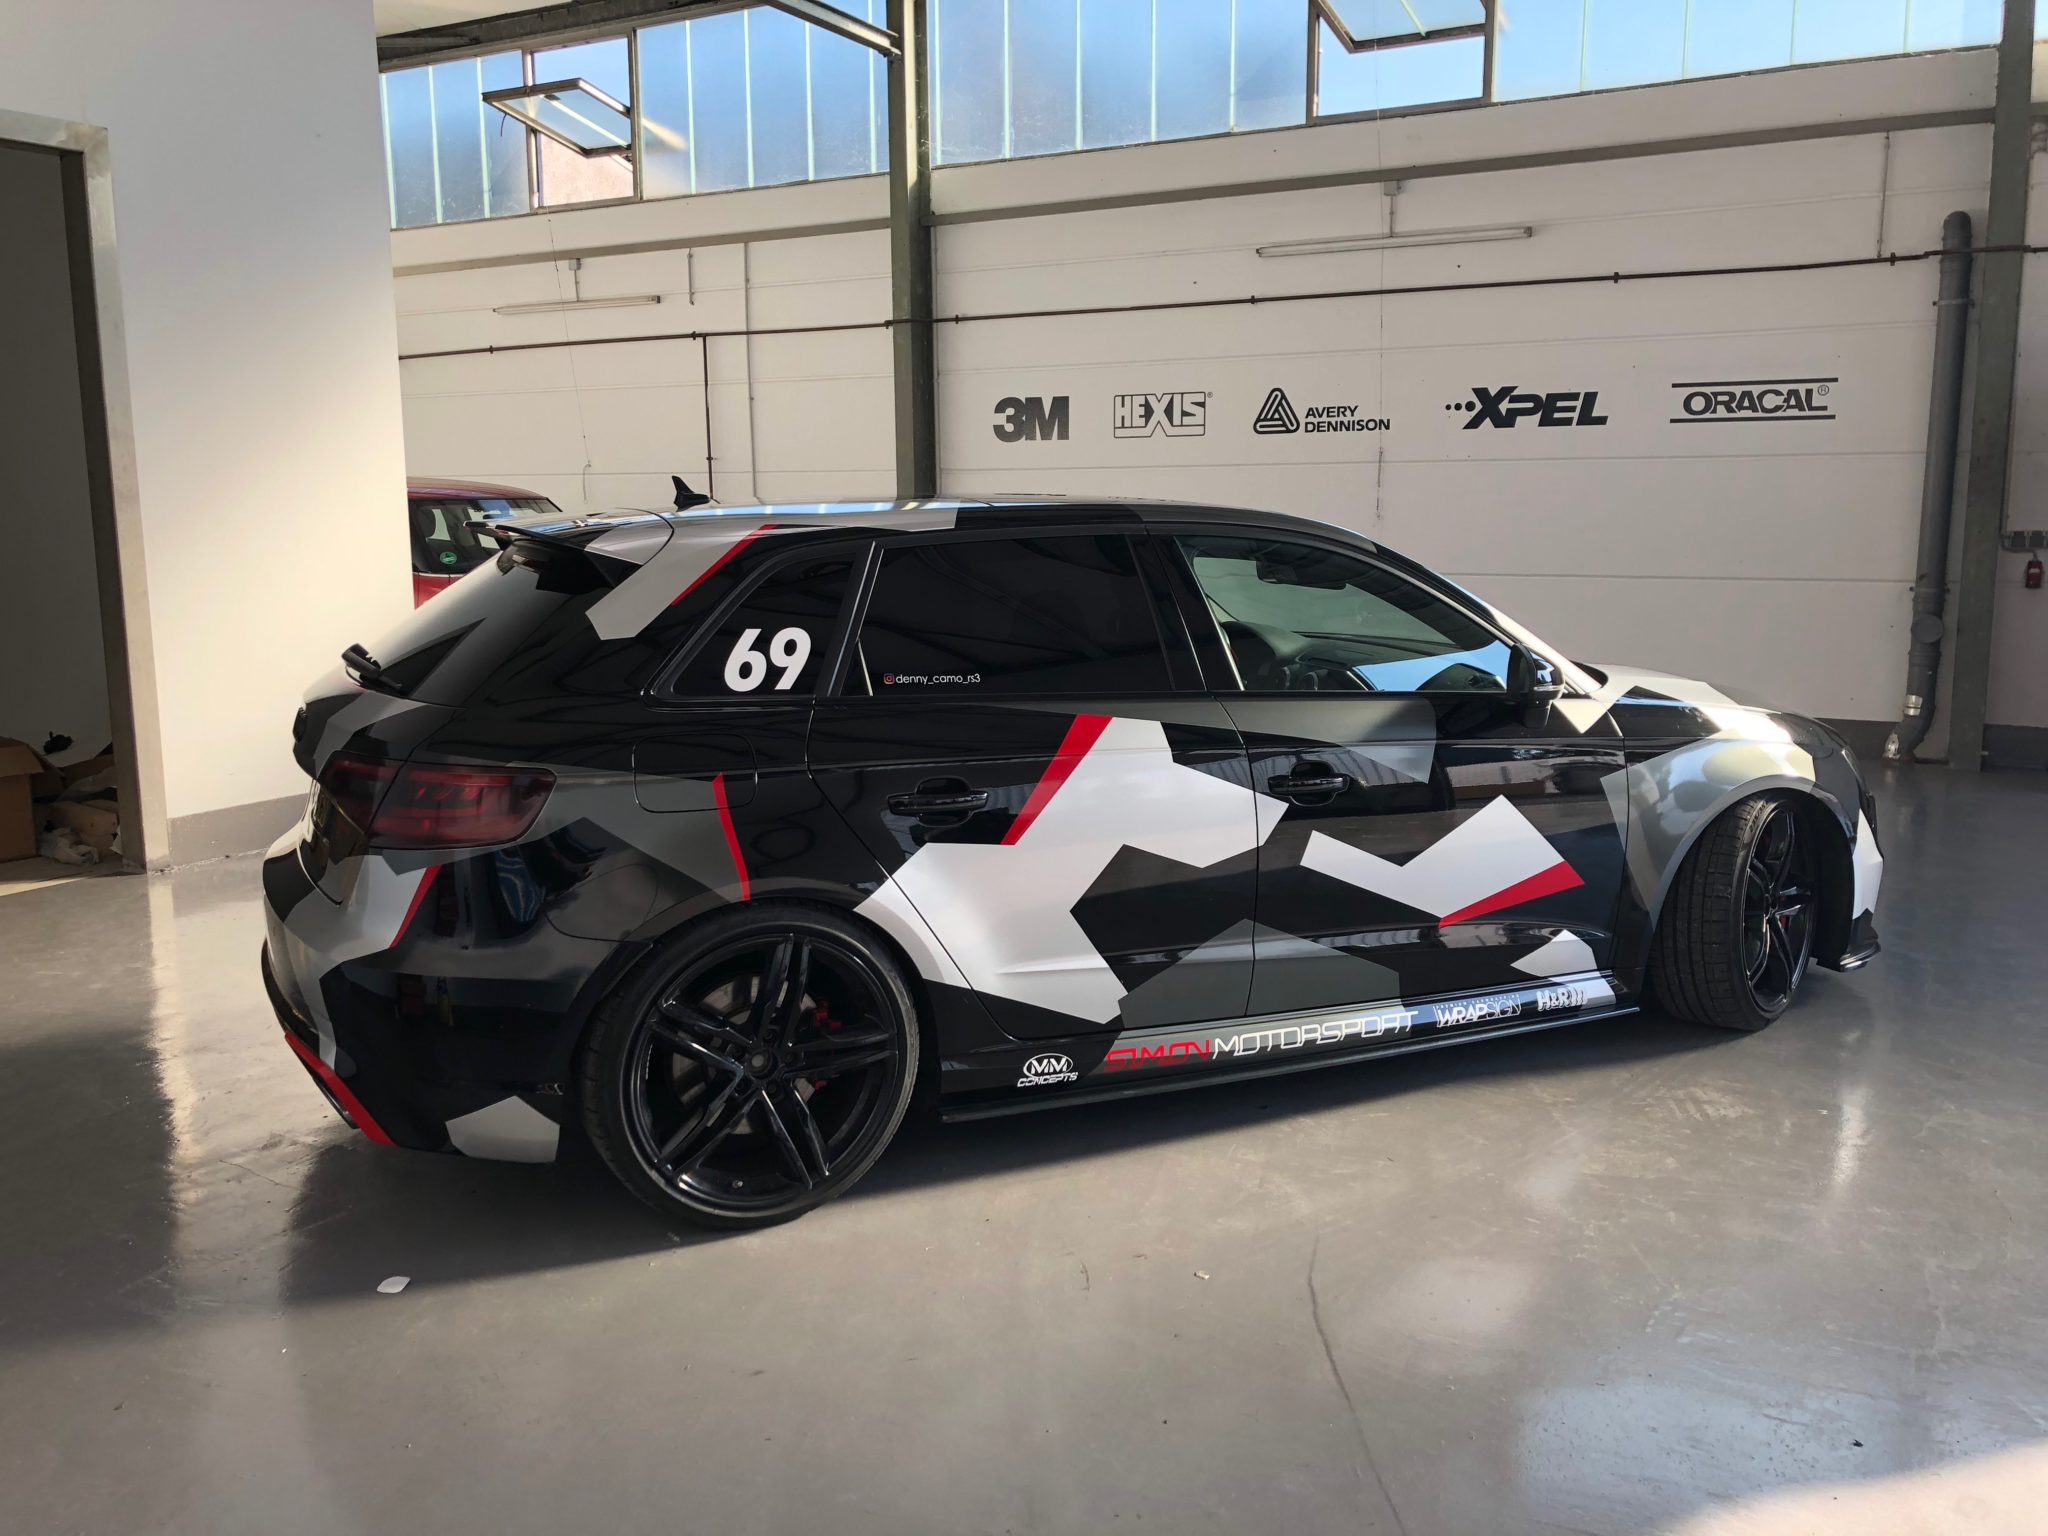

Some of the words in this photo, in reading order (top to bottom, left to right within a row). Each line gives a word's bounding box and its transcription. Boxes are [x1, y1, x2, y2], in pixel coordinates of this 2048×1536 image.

[993, 395, 1069, 443] 3M
[1115, 392, 1206, 432] HEXIS
[1305, 405, 1359, 419] AVERY
[1462, 385, 1608, 430] XPEL
[1304, 418, 1390, 433] DENNISON
[723, 626, 812, 692] 69
[895, 672, 981, 686] denny_camo_rs3
[1435, 998, 1522, 1027] WRAPSIGN
[1211, 1009, 1419, 1060] MOTORSPORT
[1016, 1071, 1078, 1088] CONCEPTS
